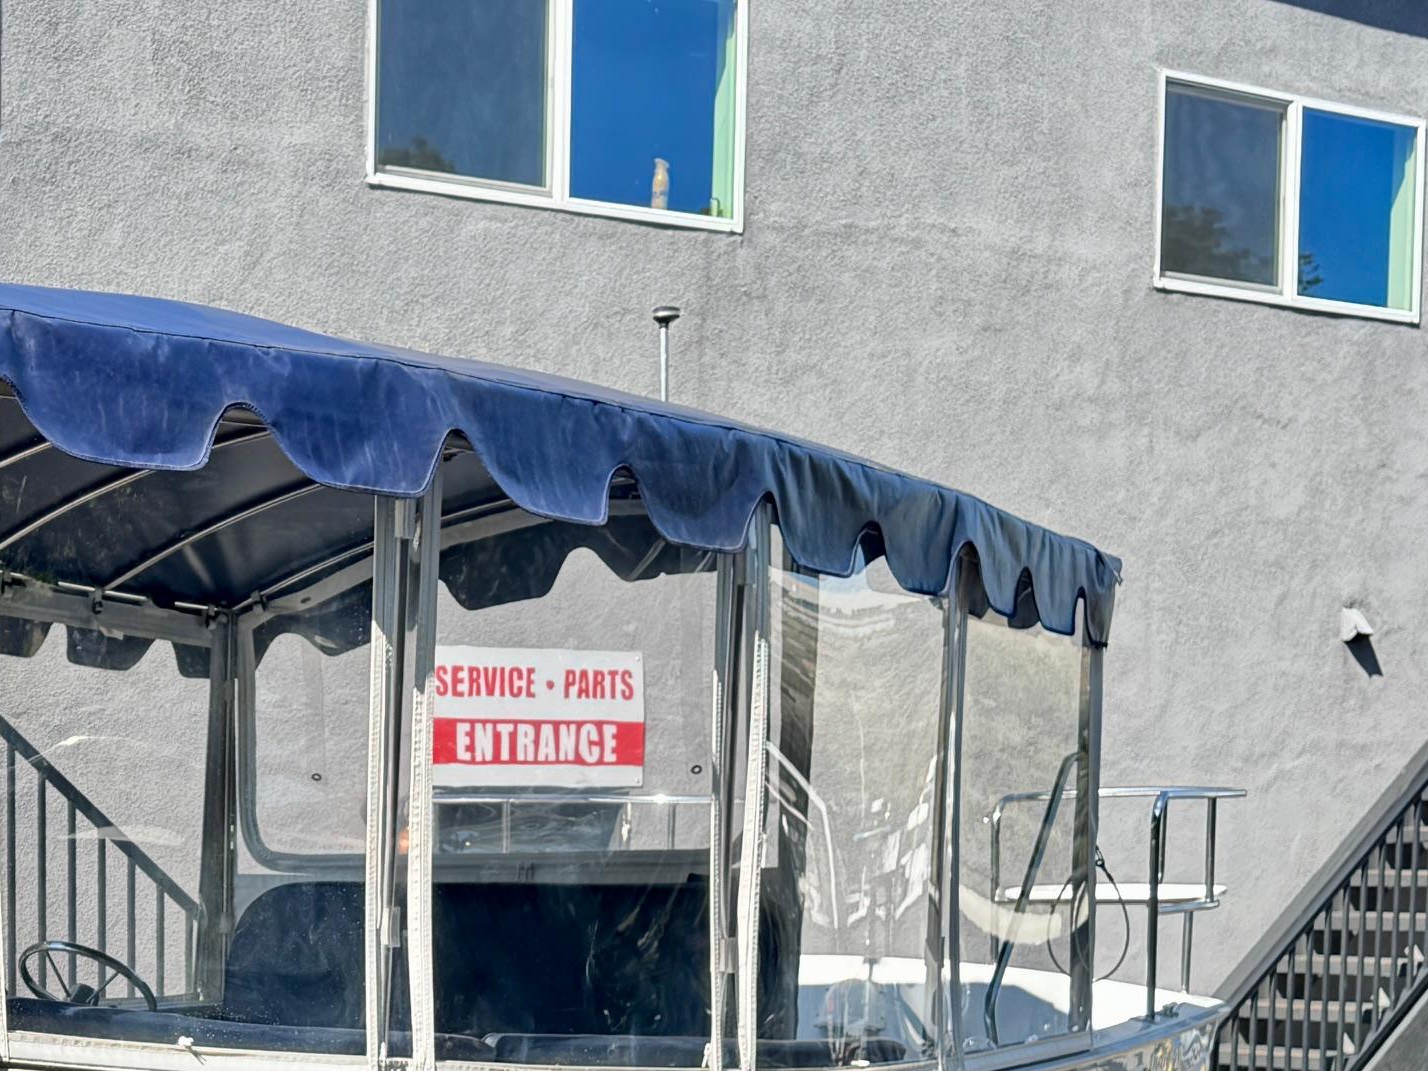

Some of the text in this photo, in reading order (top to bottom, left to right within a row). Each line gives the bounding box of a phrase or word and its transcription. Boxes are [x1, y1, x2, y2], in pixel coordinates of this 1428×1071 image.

[435, 665, 634, 700] SERVICE PARTS
[456, 722, 617, 763] ENTRANCE
